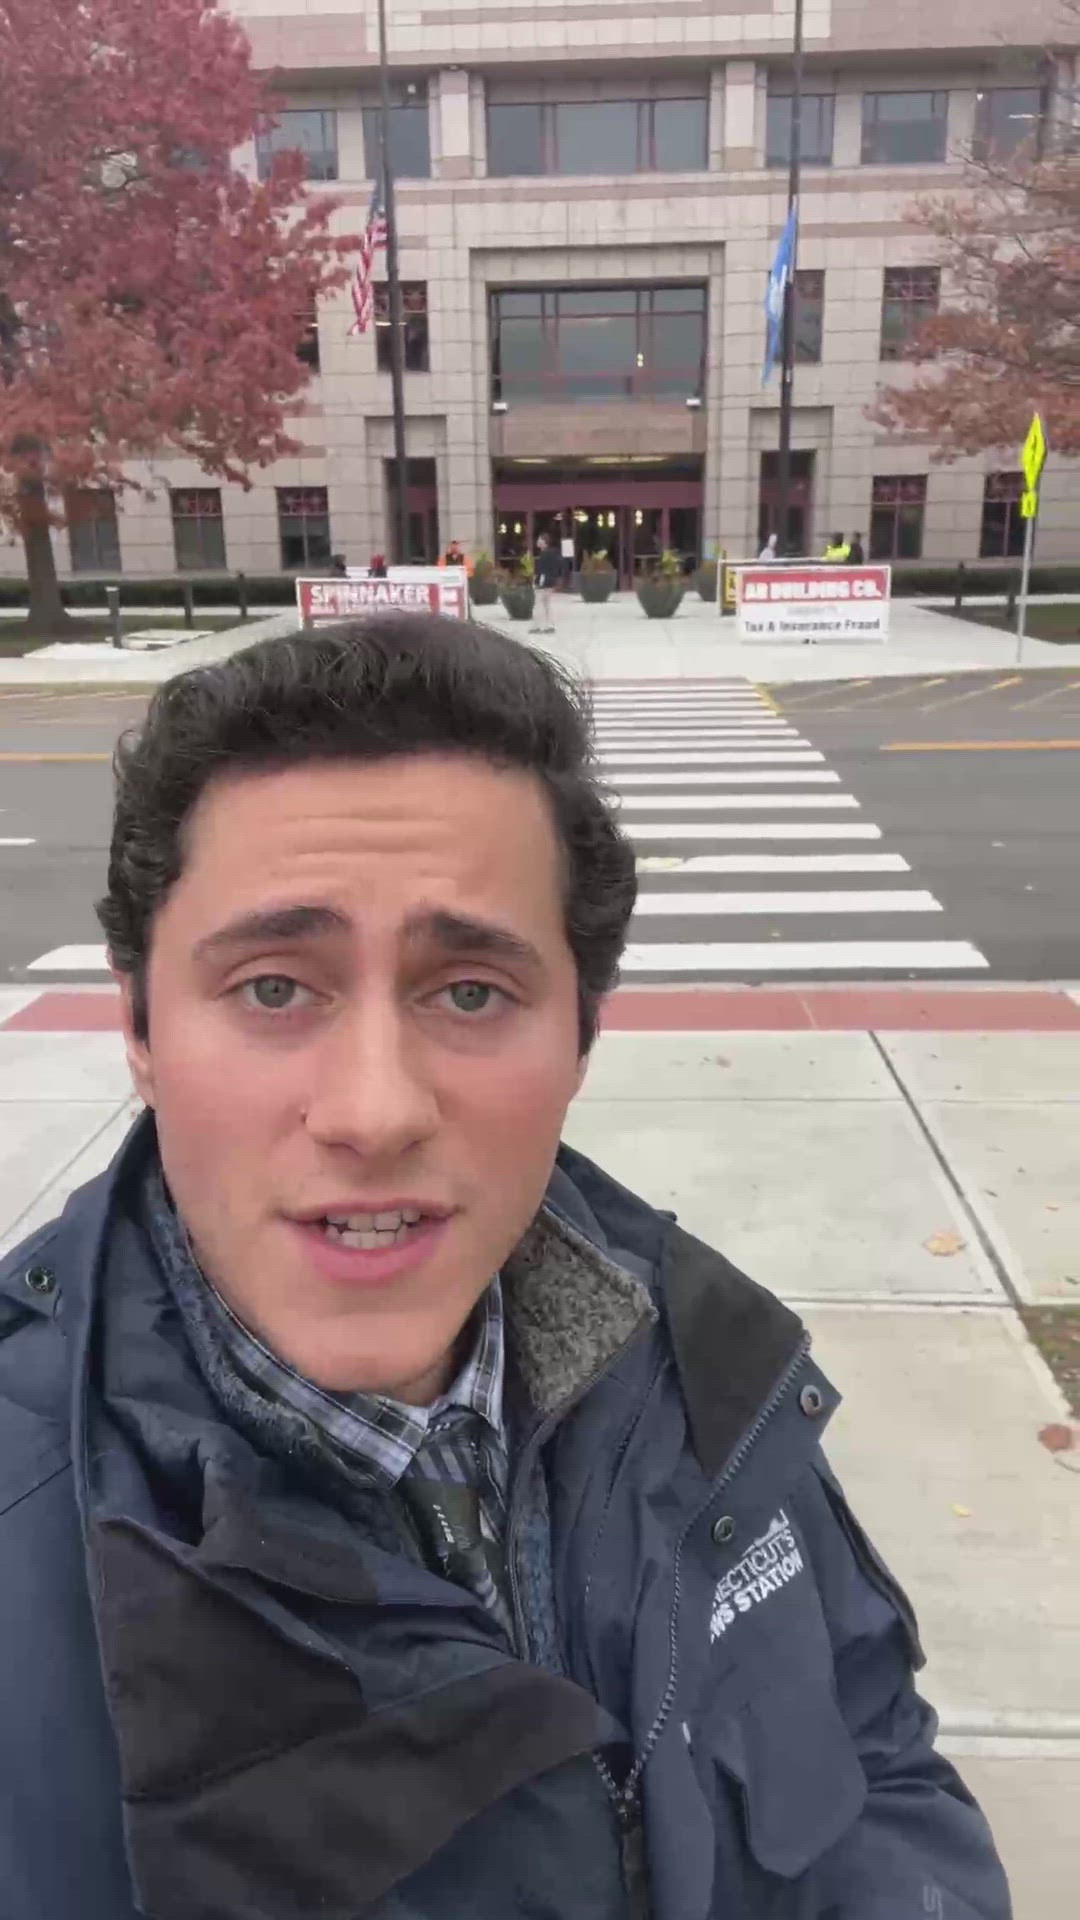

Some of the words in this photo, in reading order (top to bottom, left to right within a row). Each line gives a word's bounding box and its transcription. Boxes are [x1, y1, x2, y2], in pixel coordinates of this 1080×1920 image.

[310, 584, 430, 604] SPINNAKER
[779, 620, 841, 632] Insurance
[845, 618, 881, 630] Fraud
[733, 1548, 804, 1612] STATION
